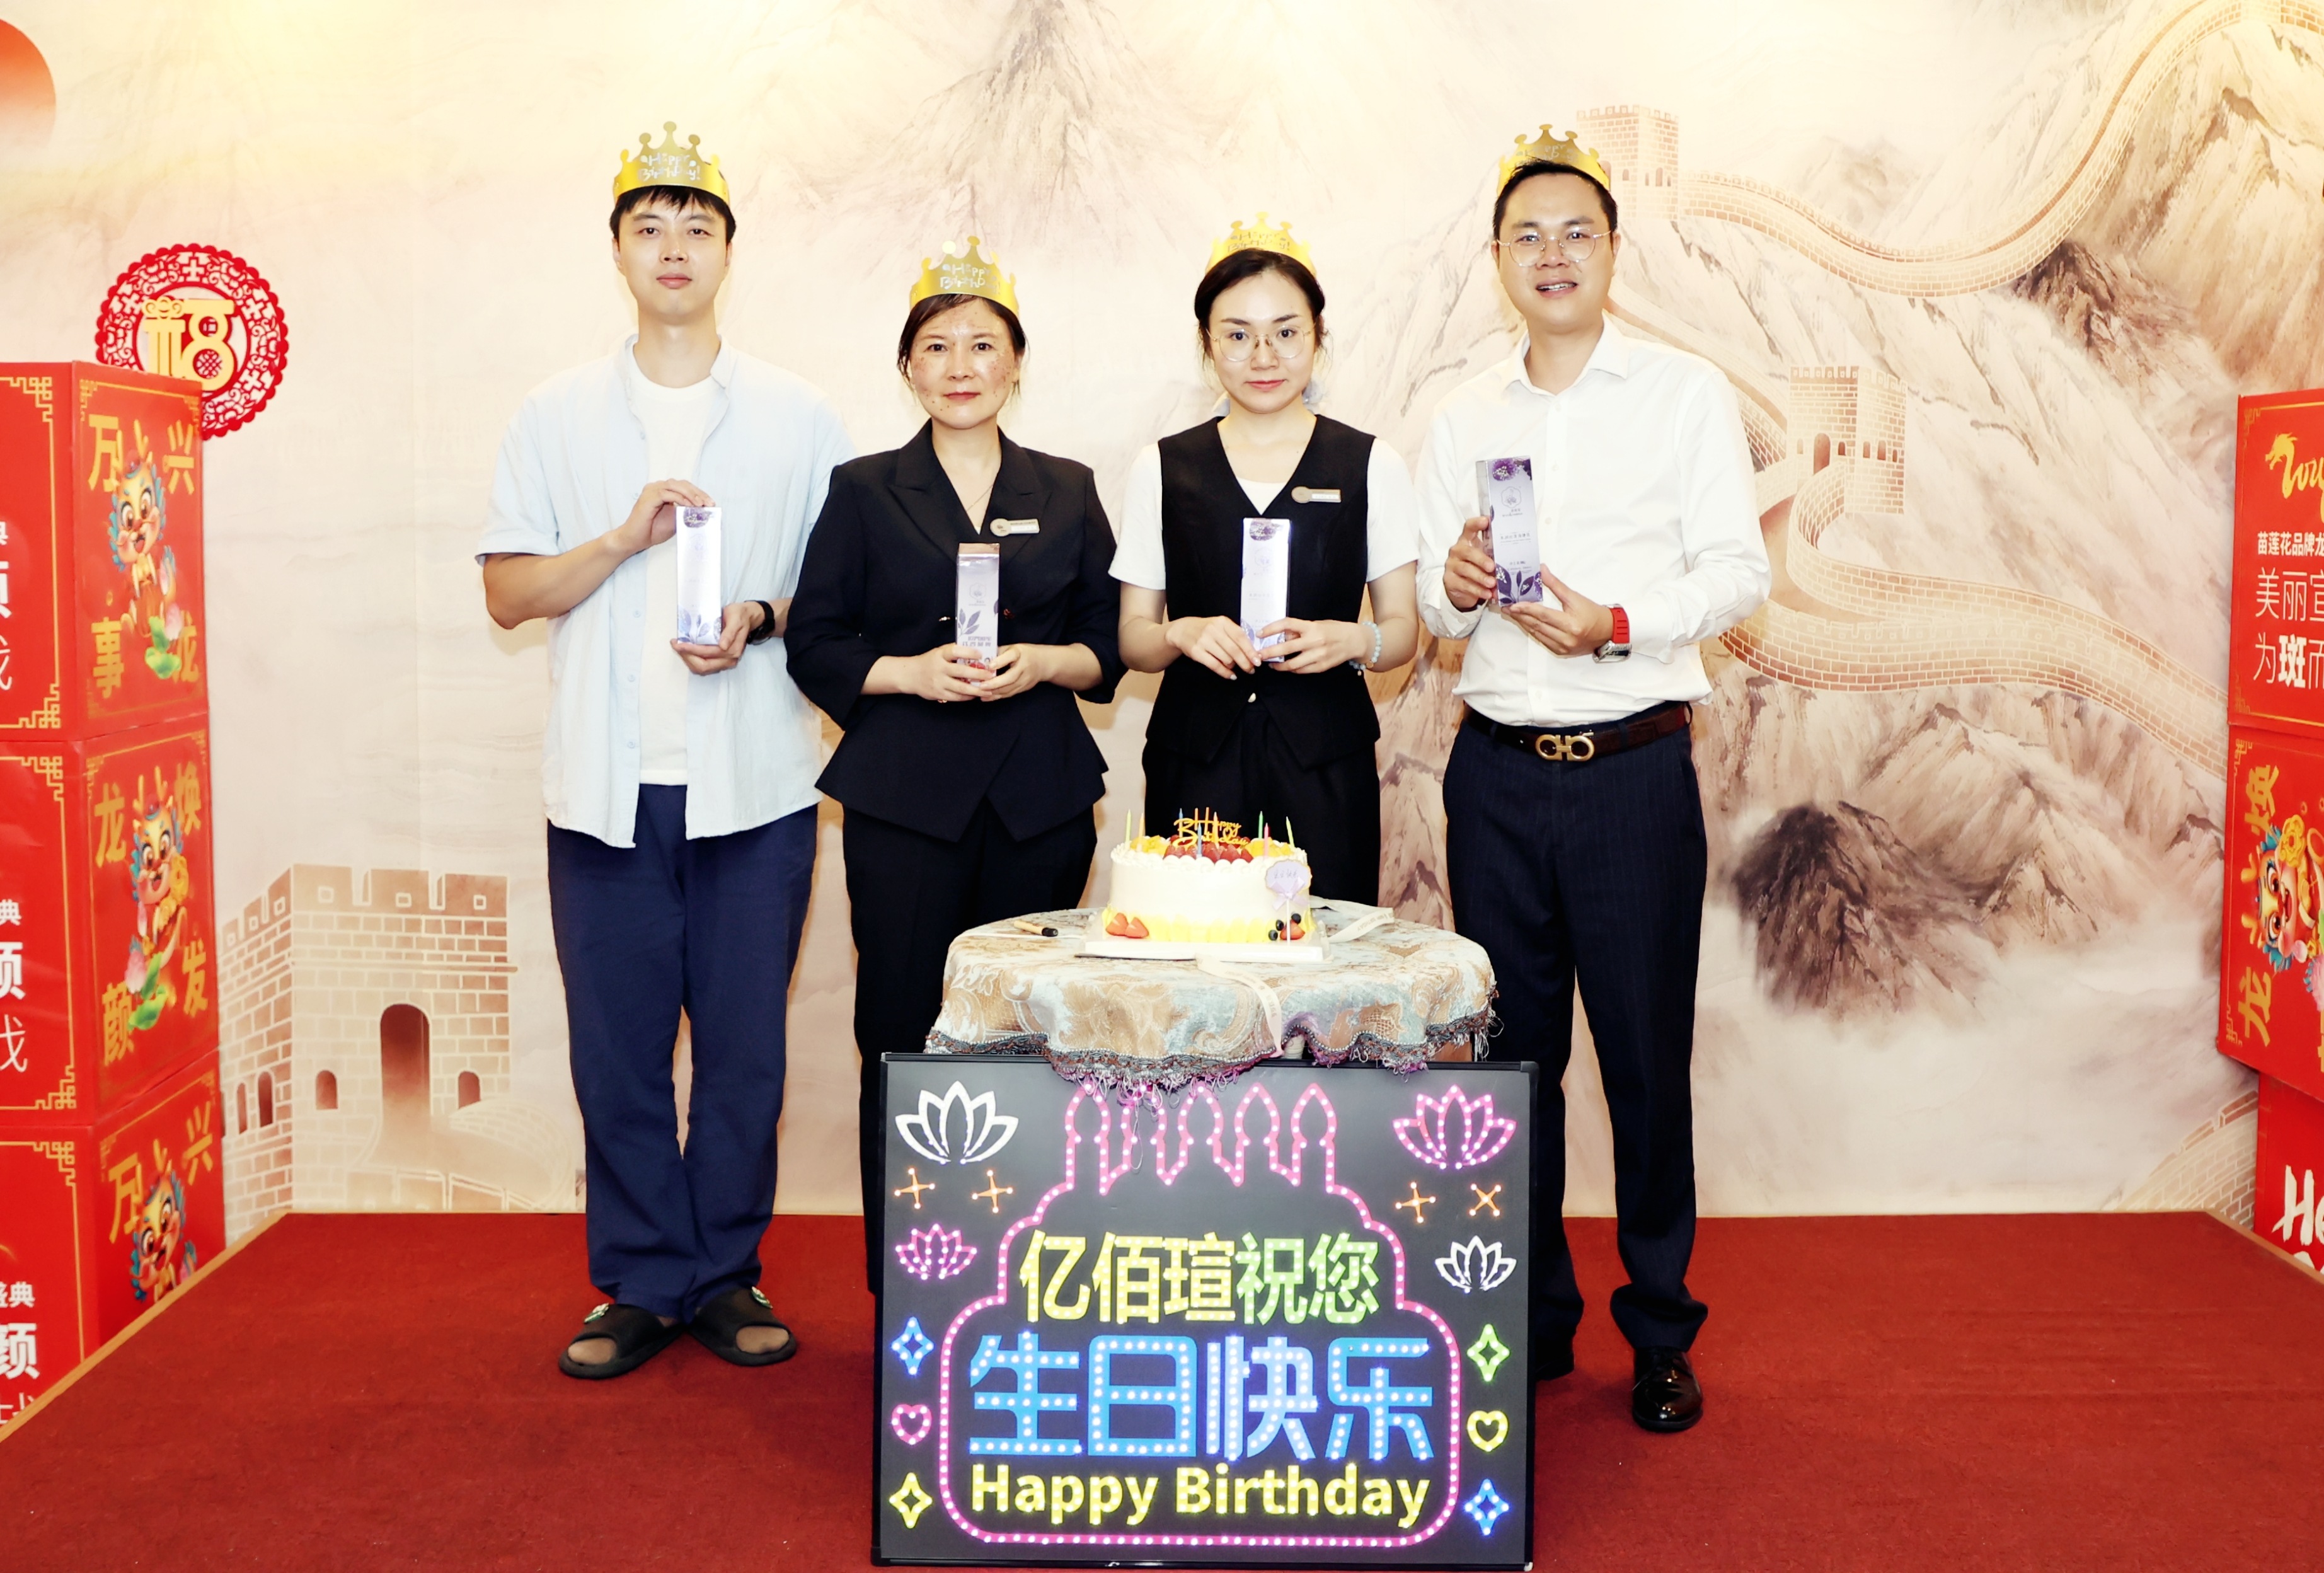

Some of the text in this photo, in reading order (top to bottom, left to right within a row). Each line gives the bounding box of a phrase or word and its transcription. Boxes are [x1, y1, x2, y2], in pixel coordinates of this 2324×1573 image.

[1019, 1229, 1380, 1325] 亿佰瑄祝您
[969, 1332, 1434, 1460] 生日快乐
[971, 1463, 1430, 1529] Happy Birthday
